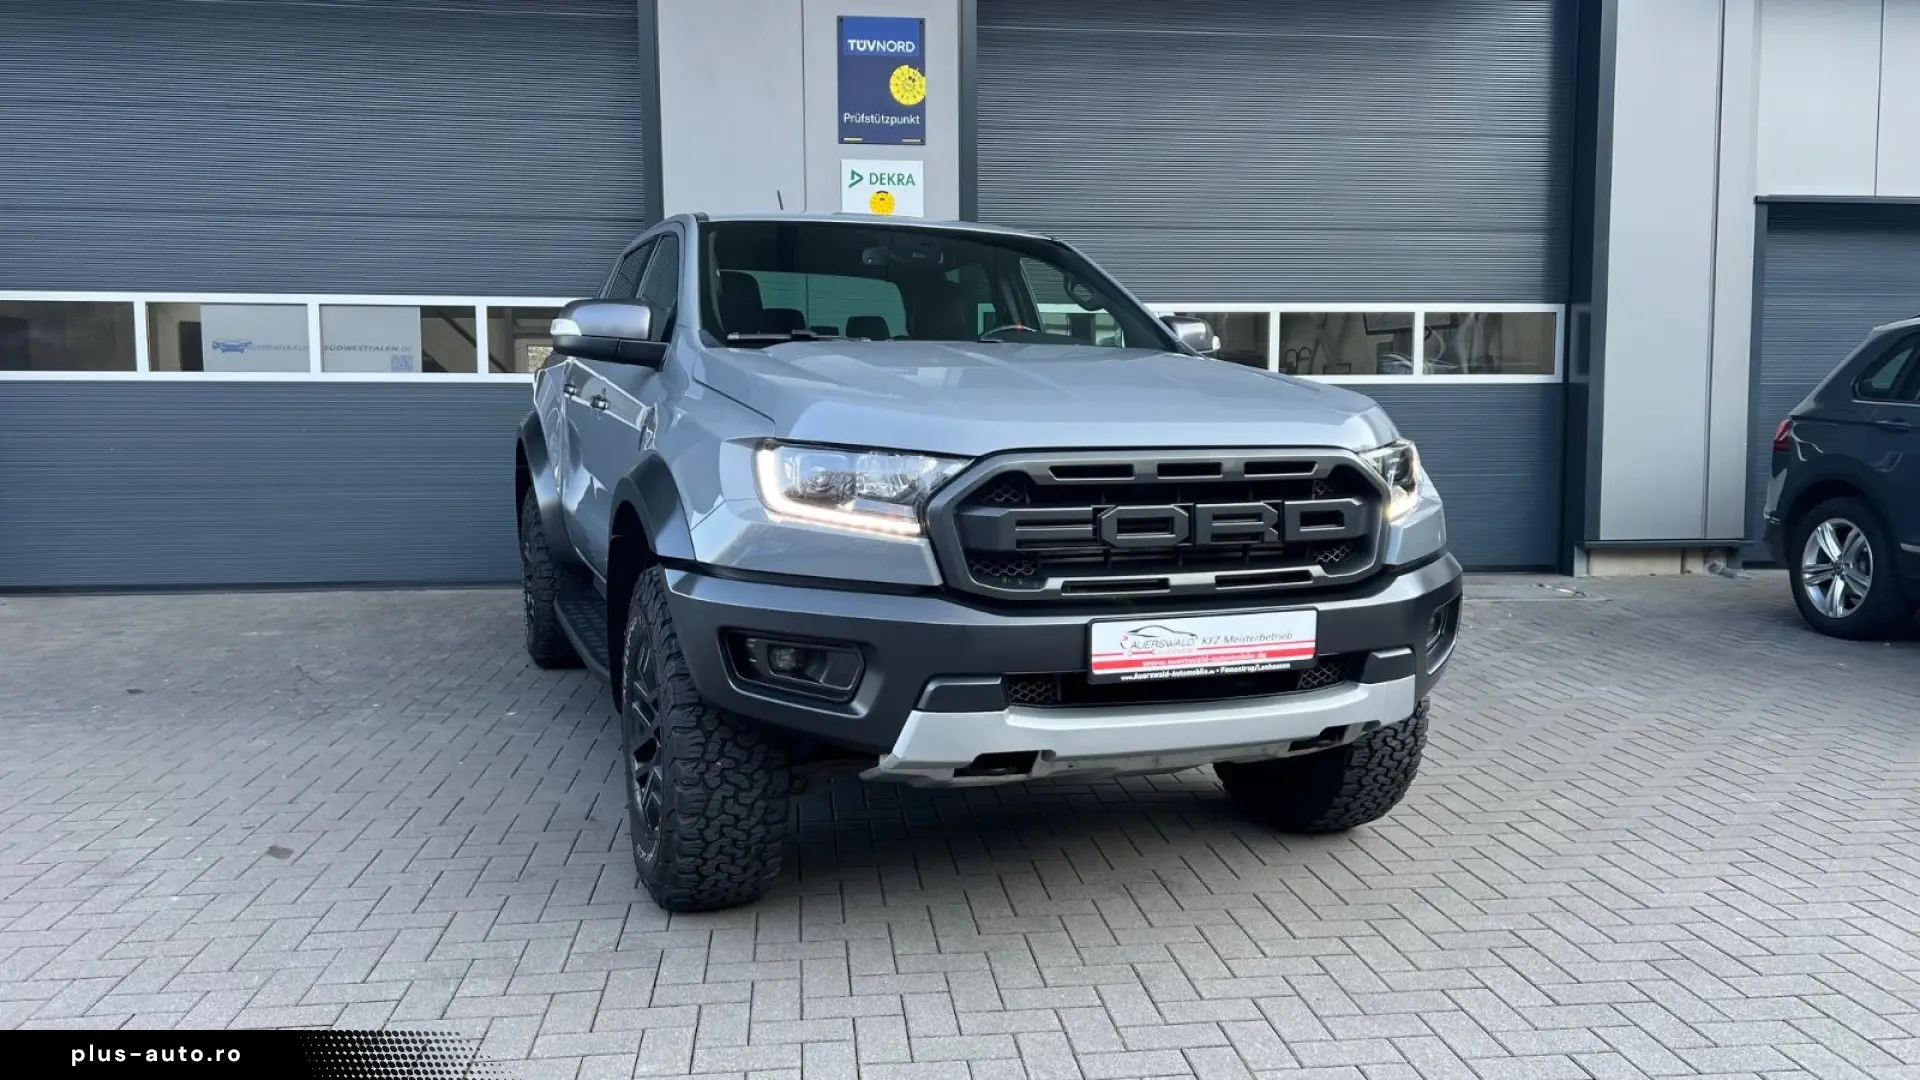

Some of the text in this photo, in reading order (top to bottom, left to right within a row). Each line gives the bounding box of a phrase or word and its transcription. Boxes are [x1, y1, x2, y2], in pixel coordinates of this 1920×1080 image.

[843, 112, 921, 127] Prüfstützpunkt
[869, 172, 916, 186] DEKRA
[990, 499, 1367, 552] FORD
[1131, 637, 1195, 651] AUERSWALD
[1223, 632, 1294, 645] Meisterbetrieb
